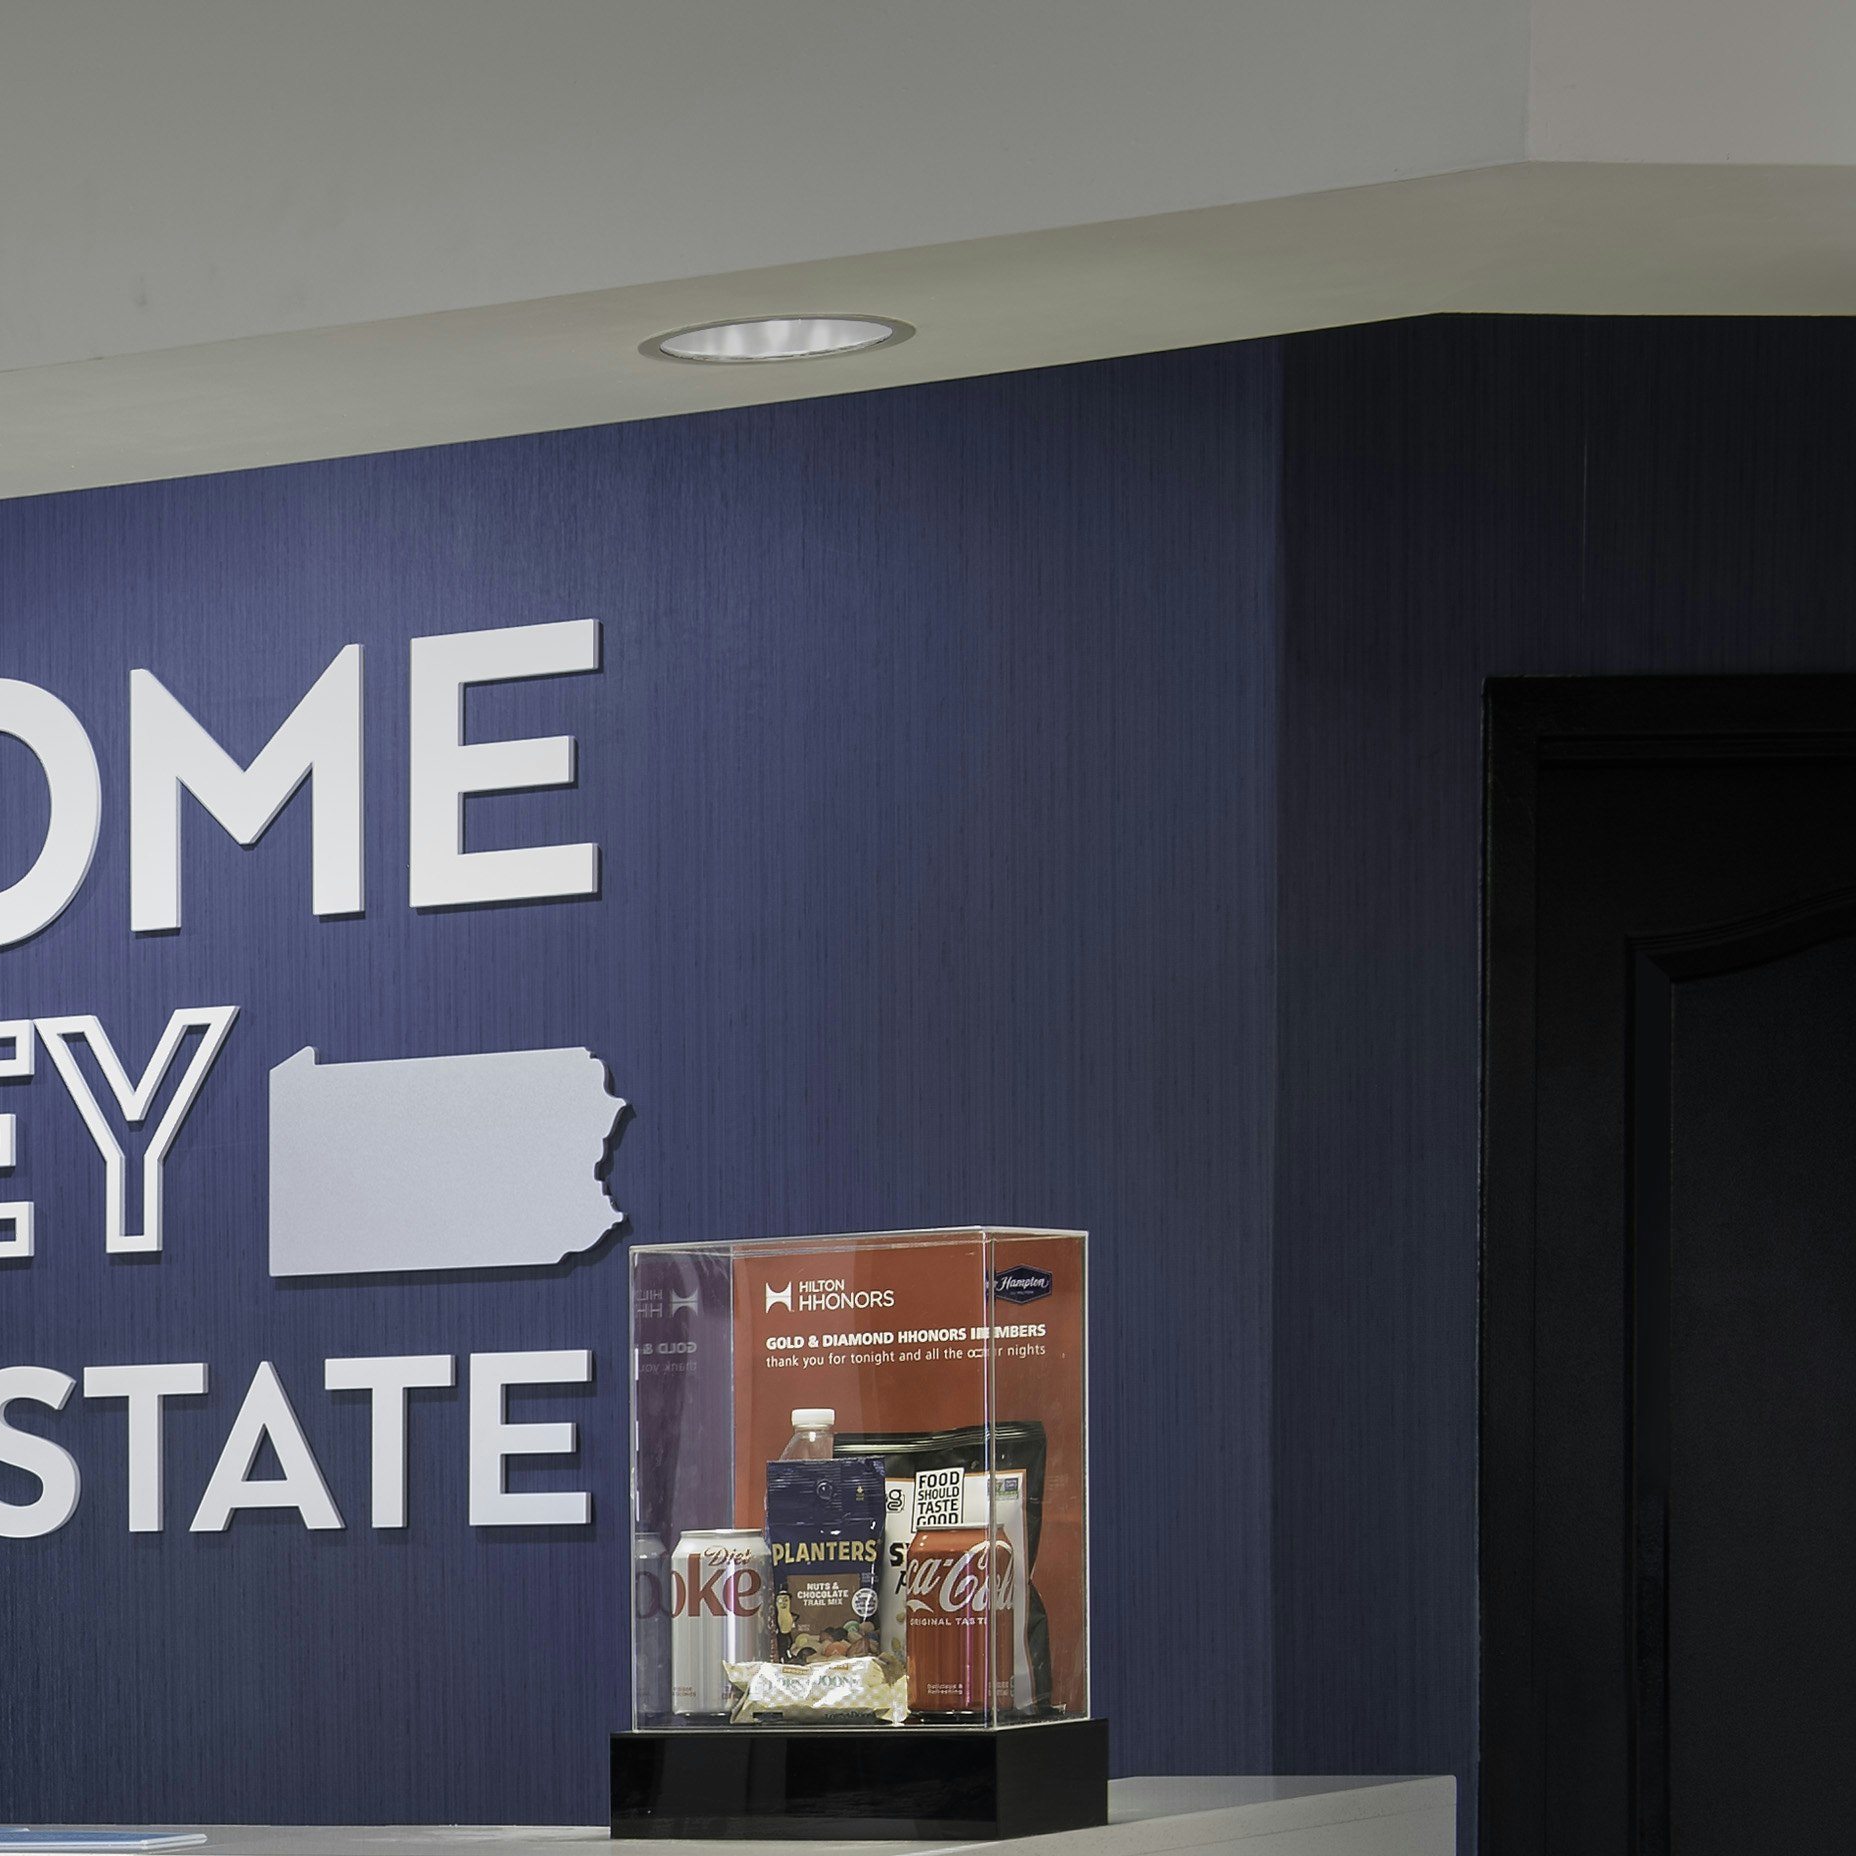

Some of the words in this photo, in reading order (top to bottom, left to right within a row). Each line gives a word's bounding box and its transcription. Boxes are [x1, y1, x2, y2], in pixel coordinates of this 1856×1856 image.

[799, 1280, 845, 1293] HILTON
[996, 1276, 1049, 1290] Hampton
[799, 1290, 895, 1312] HHONORS
[766, 1336, 805, 1350] GOLD
[808, 1335, 819, 1348] &
[822, 1332, 894, 1348] DIAMOND
[898, 1327, 967, 1343] HHONORS
[766, 1355, 799, 1368] thank
[803, 1356, 825, 1369] you
[828, 1353, 846, 1365] for
[851, 1350, 895, 1367] tonight
[899, 1349, 921, 1362] and
[925, 1348, 939, 1361] all
[944, 1347, 963, 1360] the
[1007, 1343, 1046, 1360] nights
[919, 1471, 960, 1489] FOOD
[918, 1486, 960, 1501] SHOULD
[918, 1499, 959, 1515] TASTE
[704, 1546, 752, 1566] Diet
[772, 1539, 878, 1567] PLANTERS
[832, 1582, 839, 1590] &
[797, 1590, 849, 1599] CHOCOLATE
[828, 1598, 843, 1606] MIX
[955, 1617, 988, 1626] TAST
